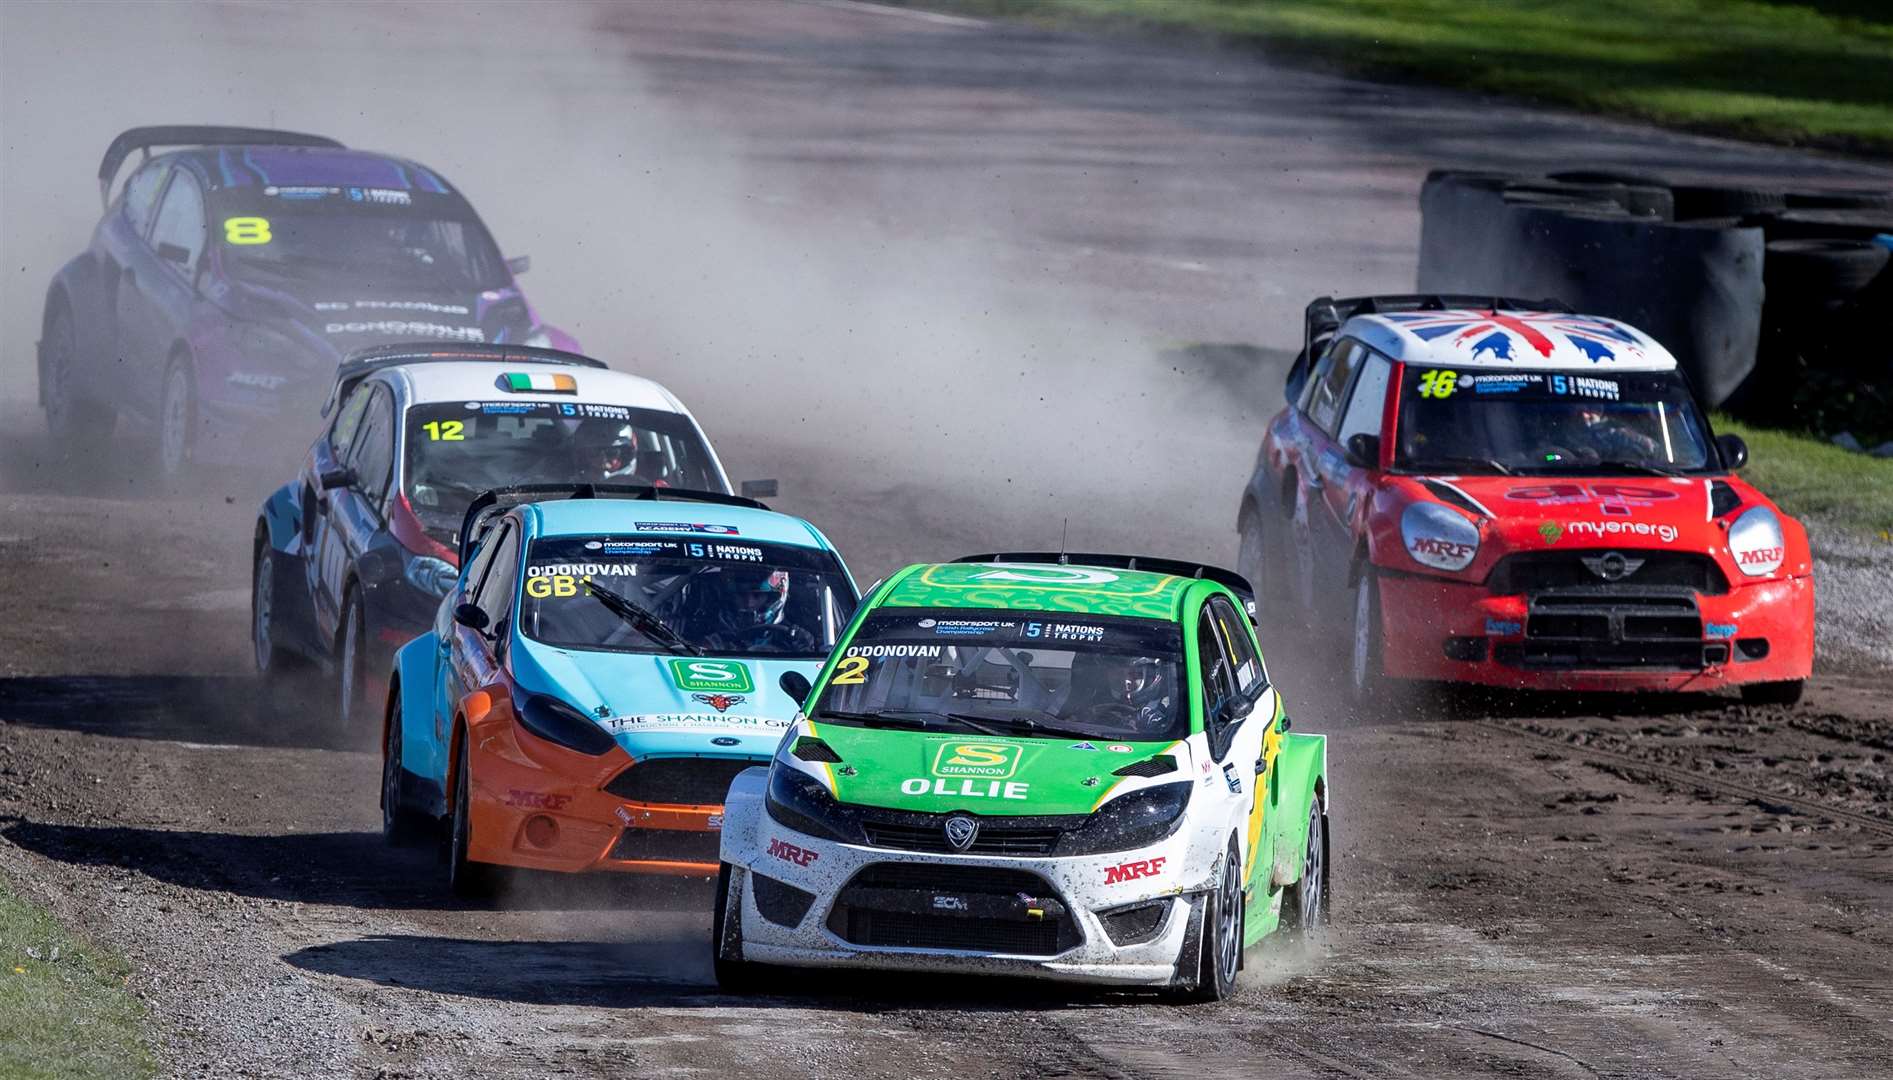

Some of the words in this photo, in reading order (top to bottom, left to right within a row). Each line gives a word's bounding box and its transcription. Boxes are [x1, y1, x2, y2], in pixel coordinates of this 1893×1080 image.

[350, 187, 363, 201] 5
[223, 216, 273, 245] 8
[1420, 369, 1457, 399] 16
[1553, 375, 1567, 395] 5
[1576, 376, 1619, 392] NATIONS
[1577, 388, 1620, 401] TROPHY
[562, 404, 576, 416] 5
[585, 404, 629, 415] NATIONS
[588, 411, 630, 421] TROPHY
[422, 420, 465, 441] 12
[1567, 520, 1679, 543] myenergi
[690, 543, 704, 557] 5
[716, 544, 762, 556] NATIONS
[1413, 536, 1475, 558] MRF
[717, 552, 763, 562] TROPHY
[1738, 547, 1784, 565] MRF
[527, 562, 638, 577] O'DONOVAN
[937, 620, 1000, 628] motorsport
[1026, 622, 1042, 637] 5
[1055, 623, 1104, 636] NATIONS
[1054, 632, 1103, 642] TROPHY
[846, 645, 941, 658] O'DONOVAN
[831, 656, 871, 685] 2
[689, 681, 742, 689] SHANNON
[607, 716, 647, 729] THE
[656, 714, 758, 725] SHANNON
[941, 766, 1006, 776] SHANNON
[900, 777, 1030, 800] OLLIE
[766, 837, 819, 868] MRF
[1103, 856, 1167, 886] MRF
